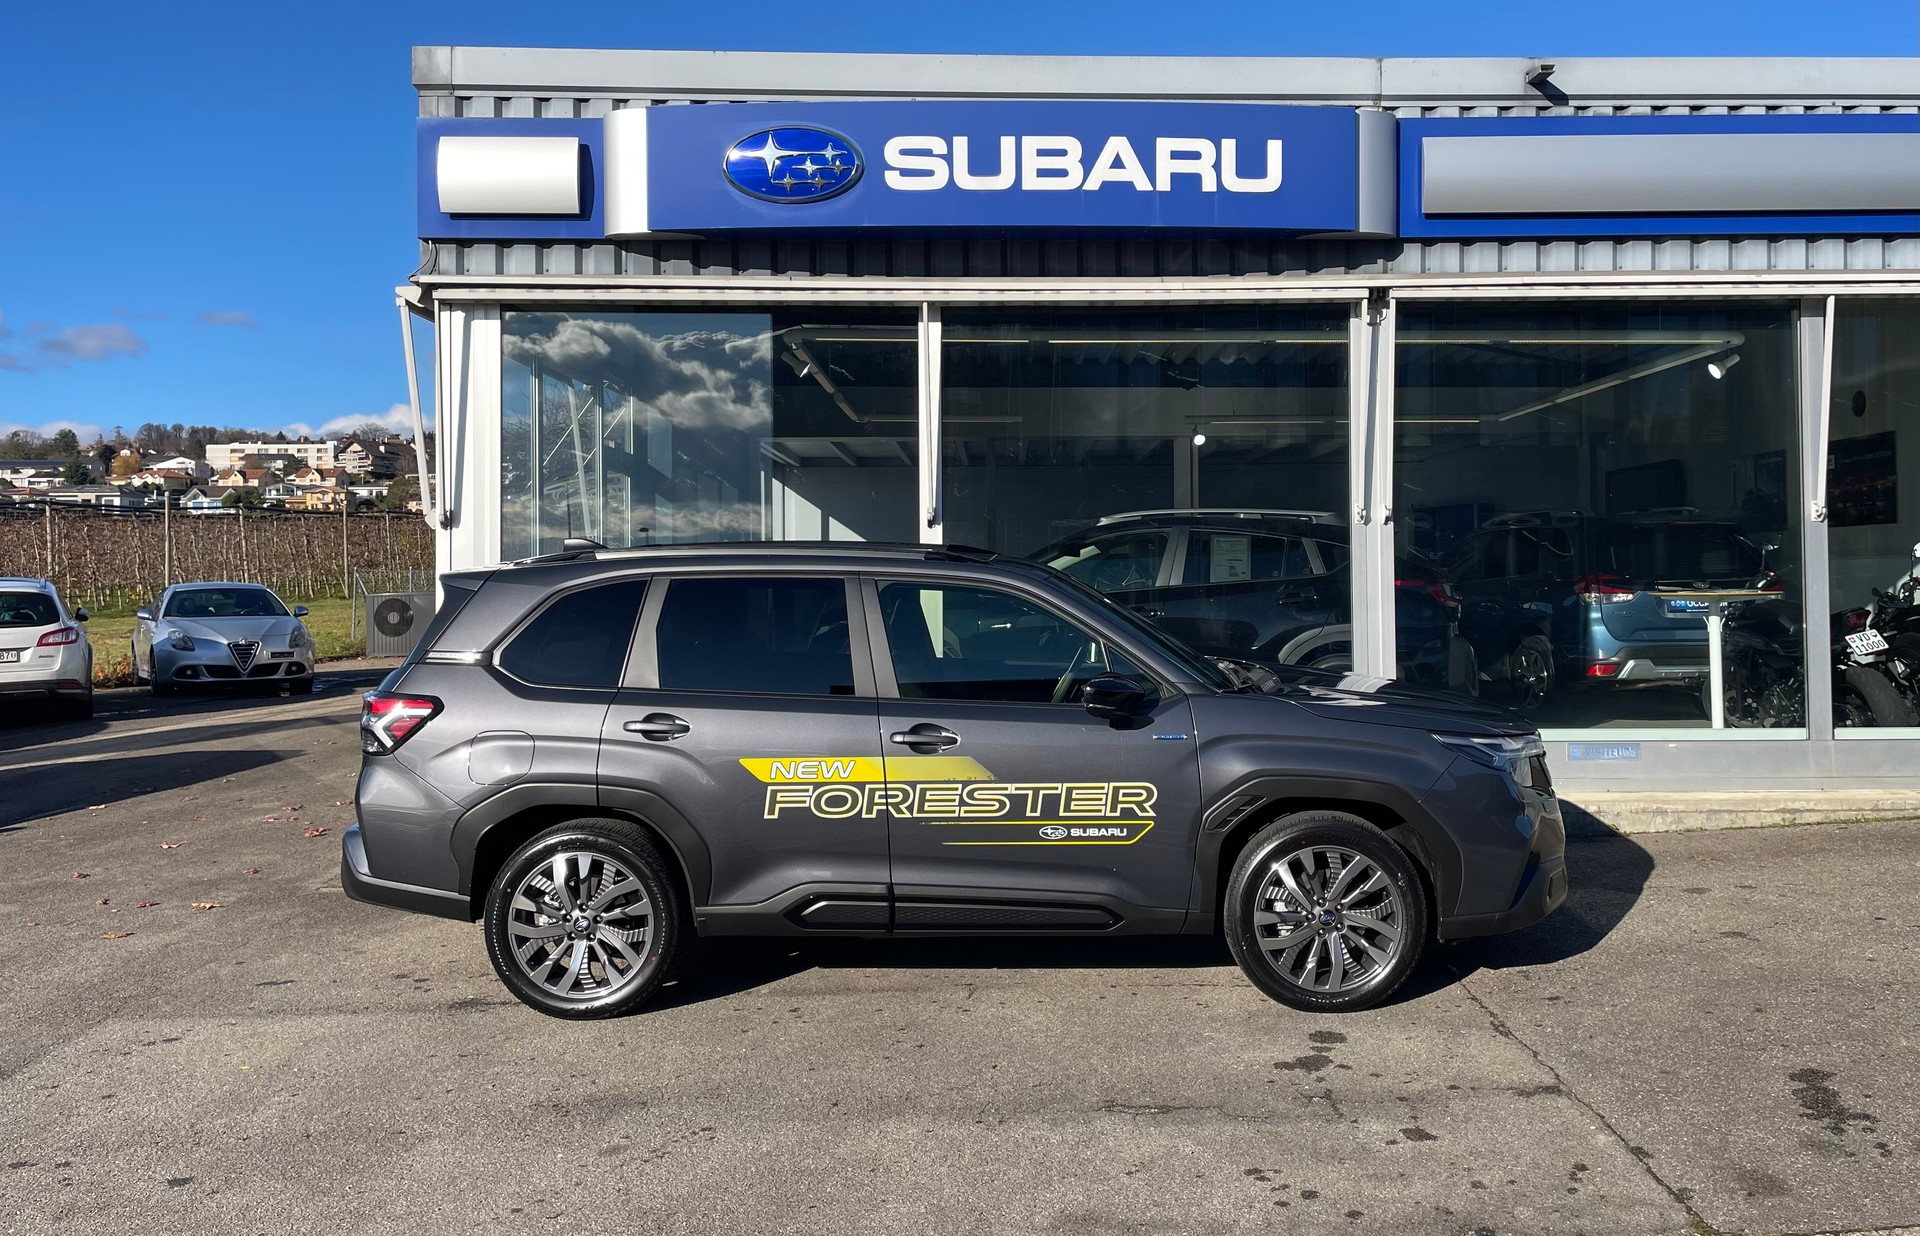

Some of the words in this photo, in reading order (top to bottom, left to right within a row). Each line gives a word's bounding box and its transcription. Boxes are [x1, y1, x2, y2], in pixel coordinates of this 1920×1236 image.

[884, 135, 1282, 193] SUBARU
[1855, 632, 1871, 642] VD
[1855, 639, 1886, 653] 11000
[770, 760, 856, 779] NEW
[763, 782, 1158, 819] FORESTER
[1070, 827, 1128, 837] SUBARU
